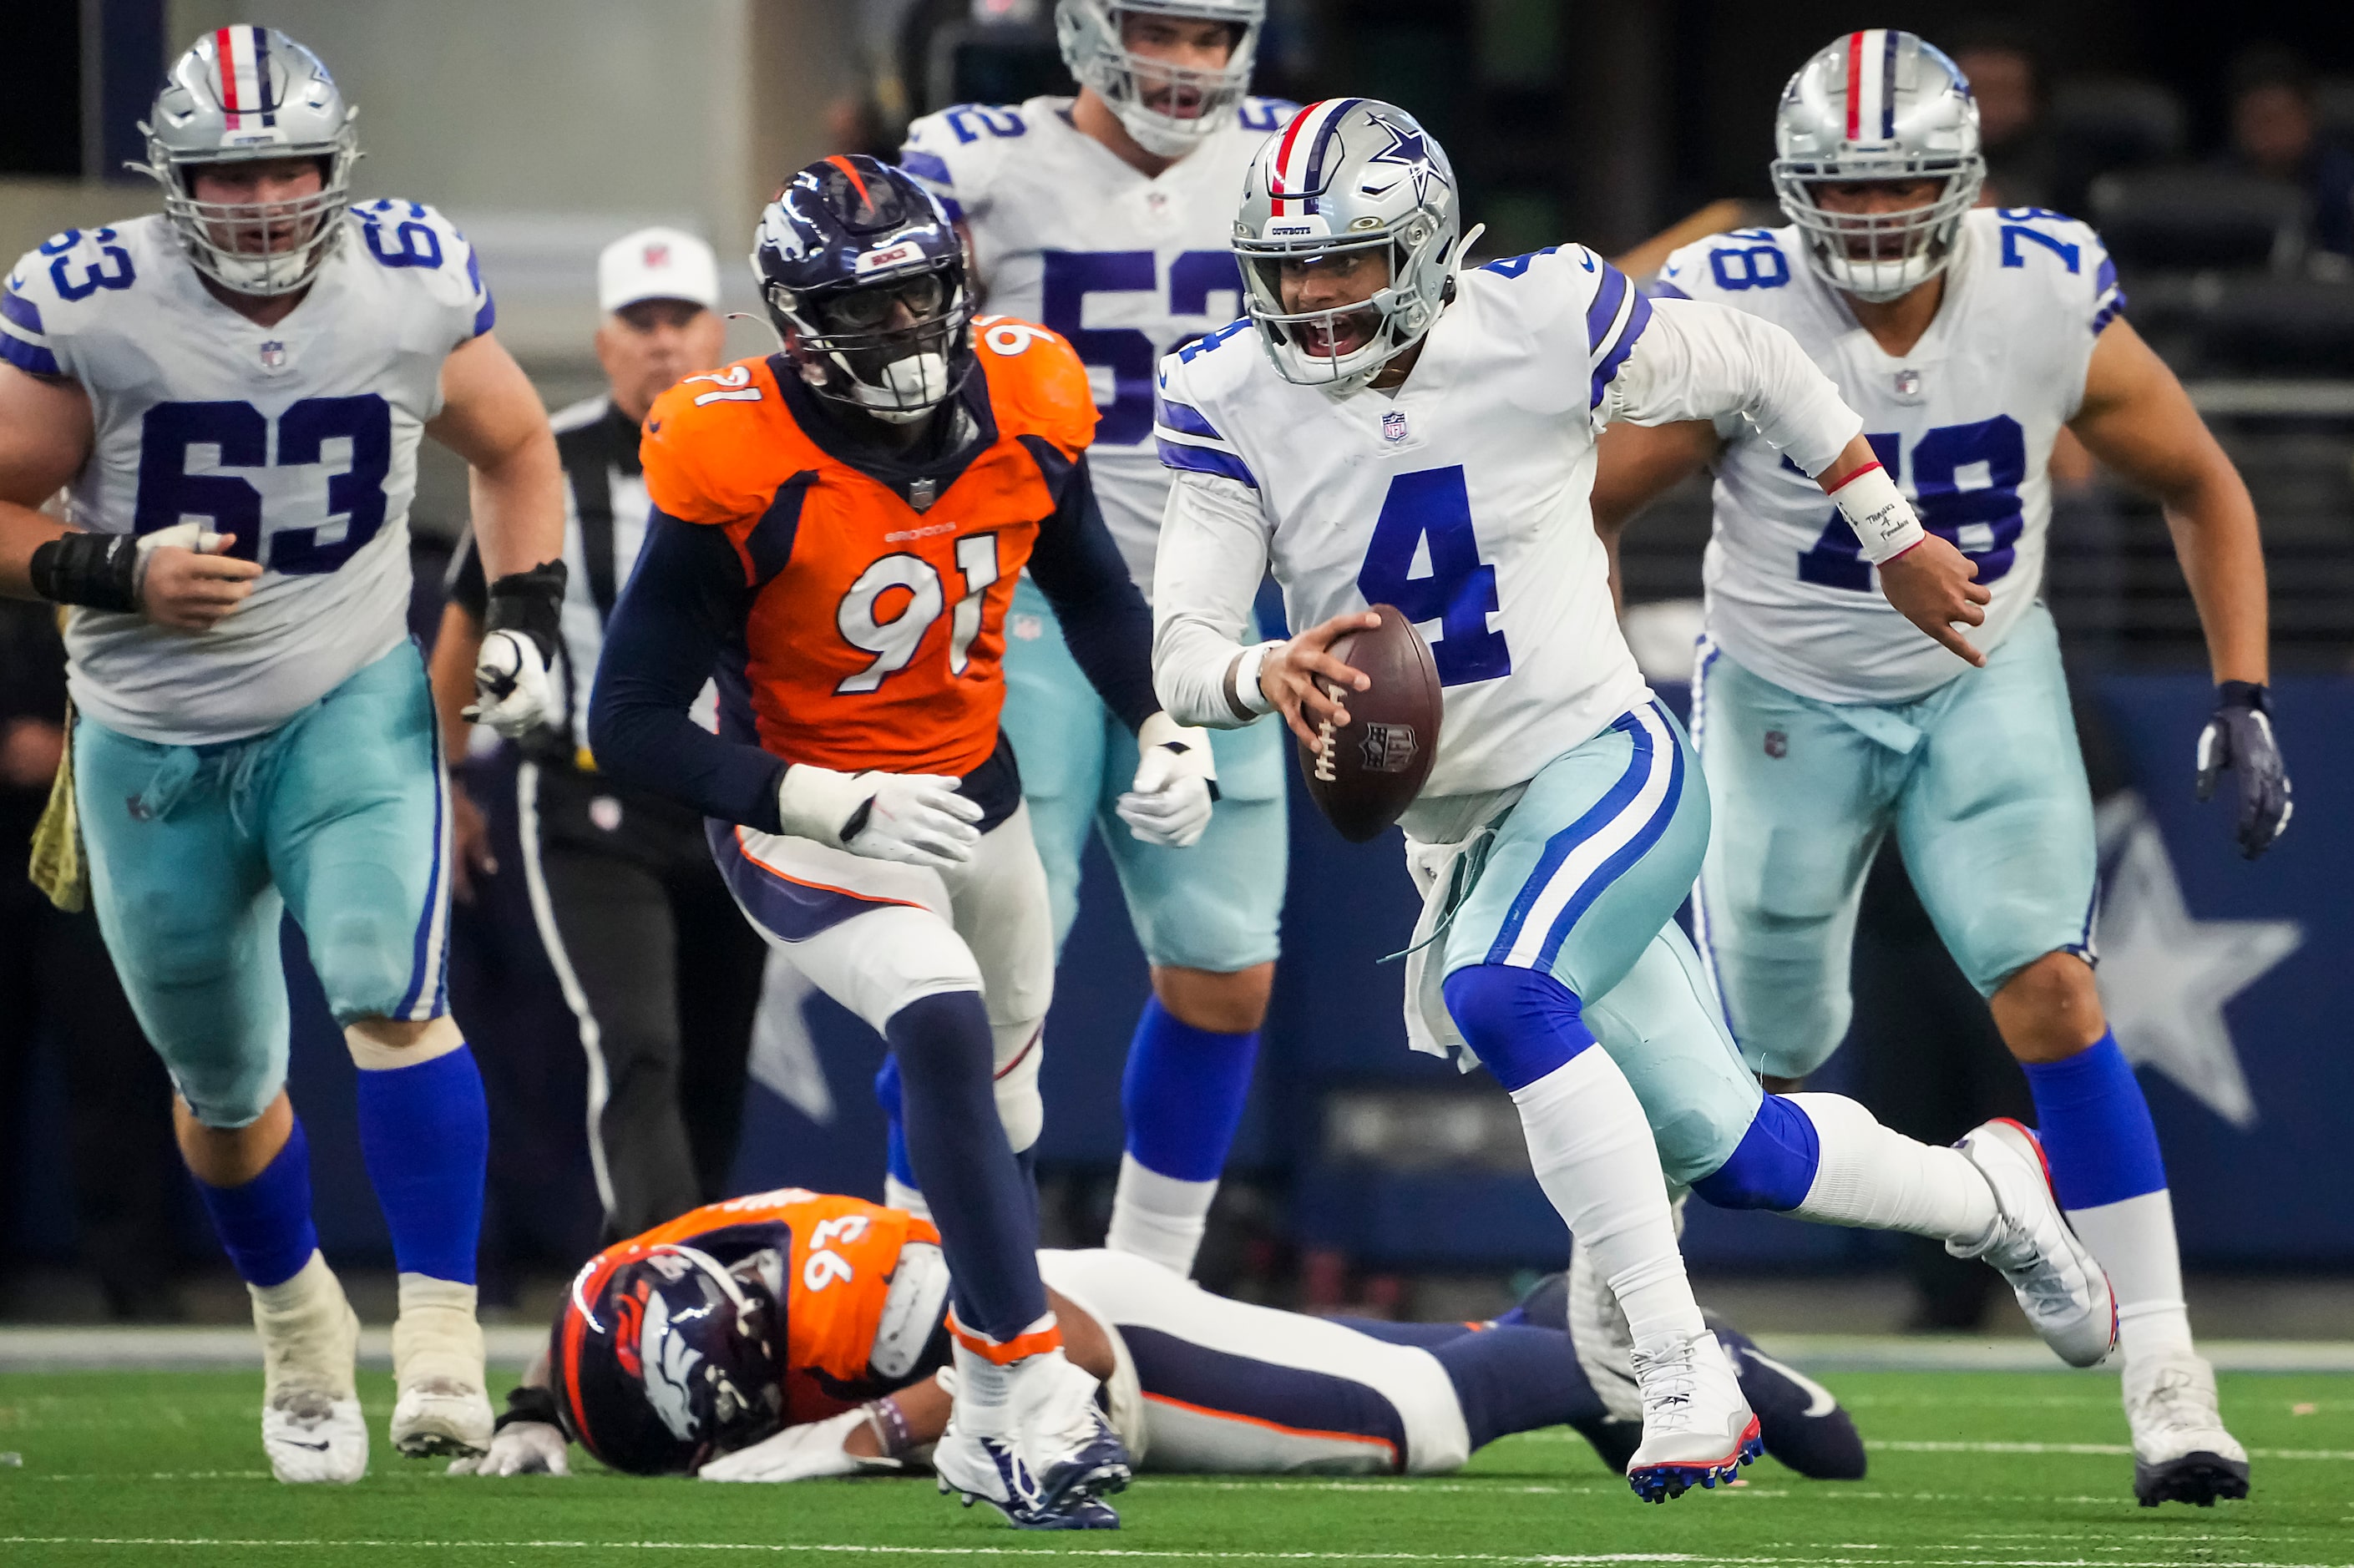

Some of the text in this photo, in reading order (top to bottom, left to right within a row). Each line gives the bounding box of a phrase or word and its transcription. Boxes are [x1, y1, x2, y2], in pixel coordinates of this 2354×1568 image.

[948, 104, 1027, 144] 2
[349, 199, 443, 269] 6
[1272, 226, 1311, 235] COWBOYS
[682, 366, 762, 407] 91
[134, 393, 391, 575] 63
[1356, 464, 1511, 688] 4
[831, 530, 1000, 697] 91
[803, 1215, 869, 1292] 93
